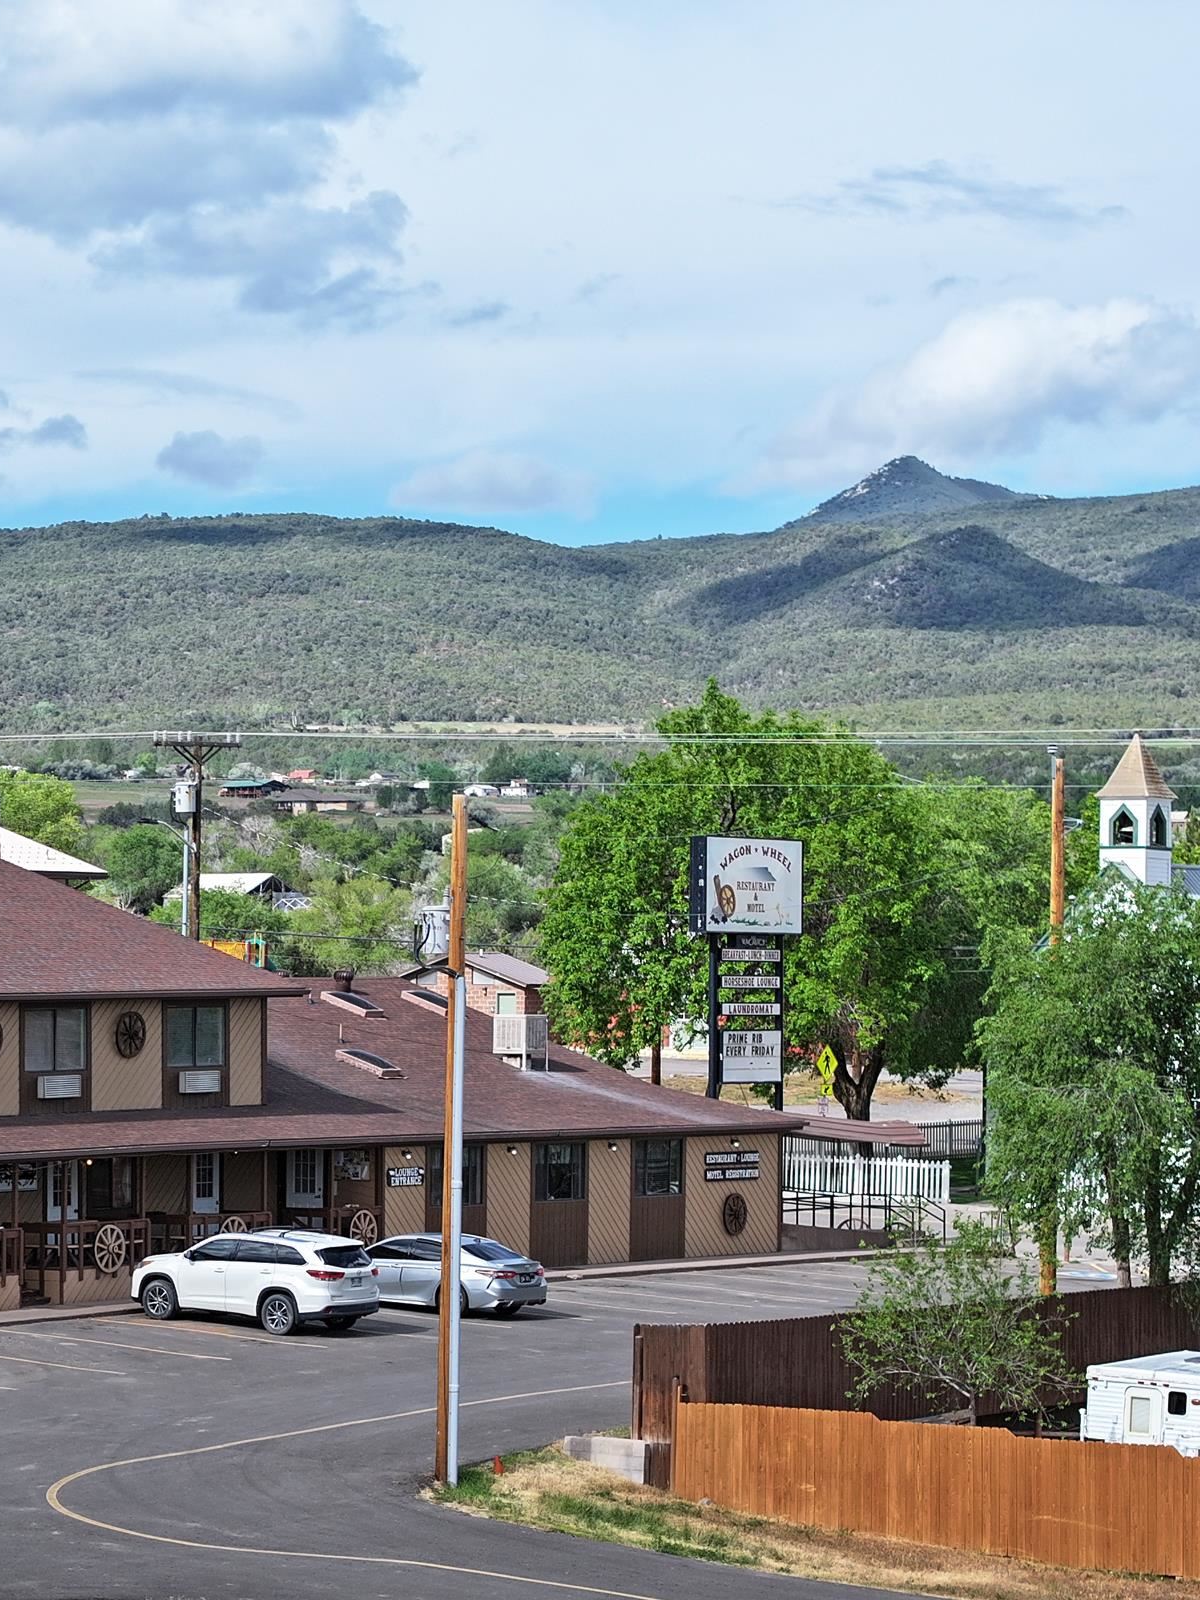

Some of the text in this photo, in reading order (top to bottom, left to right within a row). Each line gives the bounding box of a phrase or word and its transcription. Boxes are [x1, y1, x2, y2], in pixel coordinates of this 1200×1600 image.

[720, 845, 792, 873] WAGON WHEEL
[736, 881, 775, 892] RESTAURANT
[747, 903, 765, 913] MOTEL
[723, 977, 778, 987] HORSESHOE LOUNGE
[729, 1005, 774, 1014] LAUNDROMAT
[728, 1033, 763, 1044] PRIME RIB
[726, 1046, 775, 1056] EVERY FRIDAY
[706, 1153, 759, 1163] RESTAURANT LOUNGE
[394, 1167, 419, 1177] LOUNGE
[706, 1169, 759, 1180] MOTEL REGISTRATION
[391, 1176, 422, 1186] ENTRANCE
